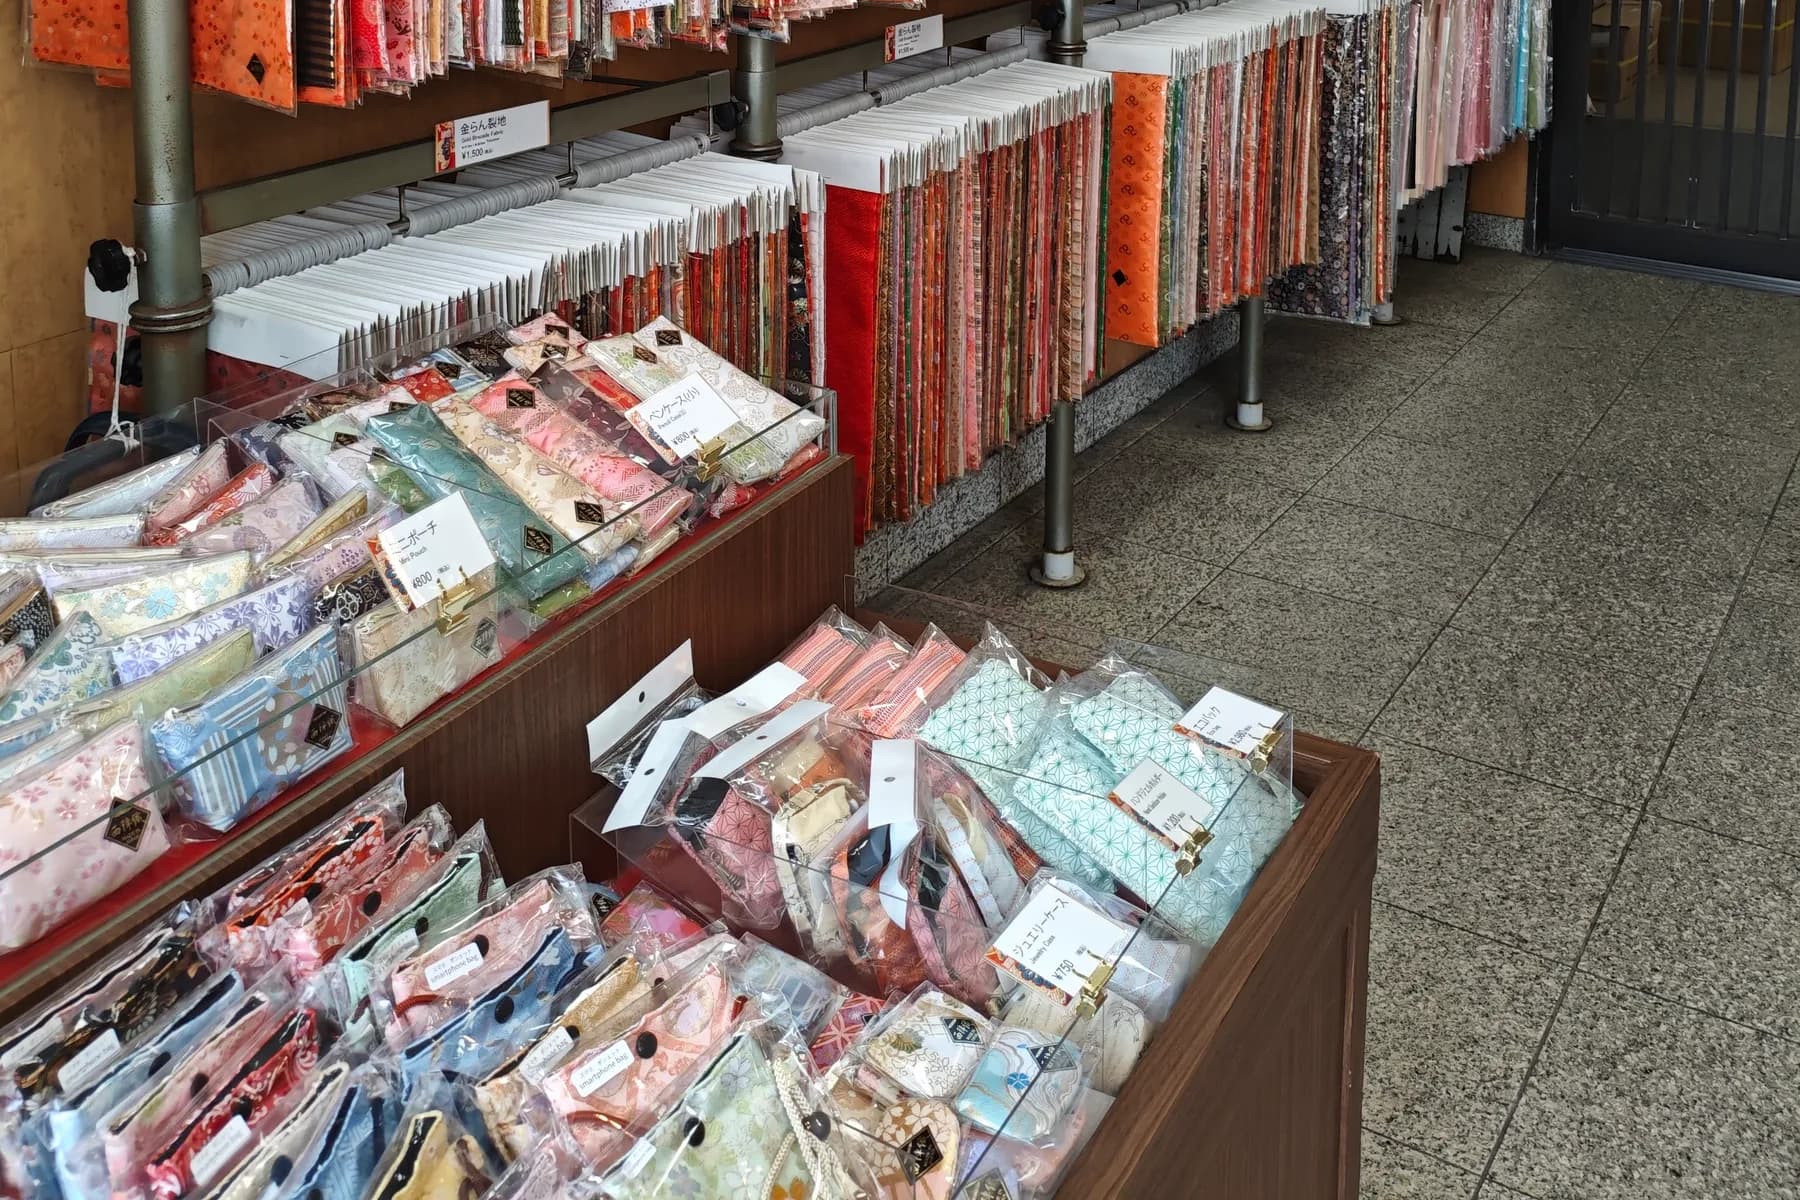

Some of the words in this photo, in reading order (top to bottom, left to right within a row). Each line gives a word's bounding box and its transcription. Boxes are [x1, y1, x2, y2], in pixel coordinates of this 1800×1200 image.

[460, 115, 507, 136] 金らん裂地
[462, 148, 484, 160] ¥1,500
[649, 386, 700, 421] ペンケース(小)
[671, 431, 690, 446] ¥800
[410, 546, 428, 559] Pouch
[1012, 897, 1069, 958] ジュエリーケース
[1052, 958, 1074, 980] ¥750
[579, 1060, 616, 1090] smartphone
[614, 1051, 628, 1064] bag
